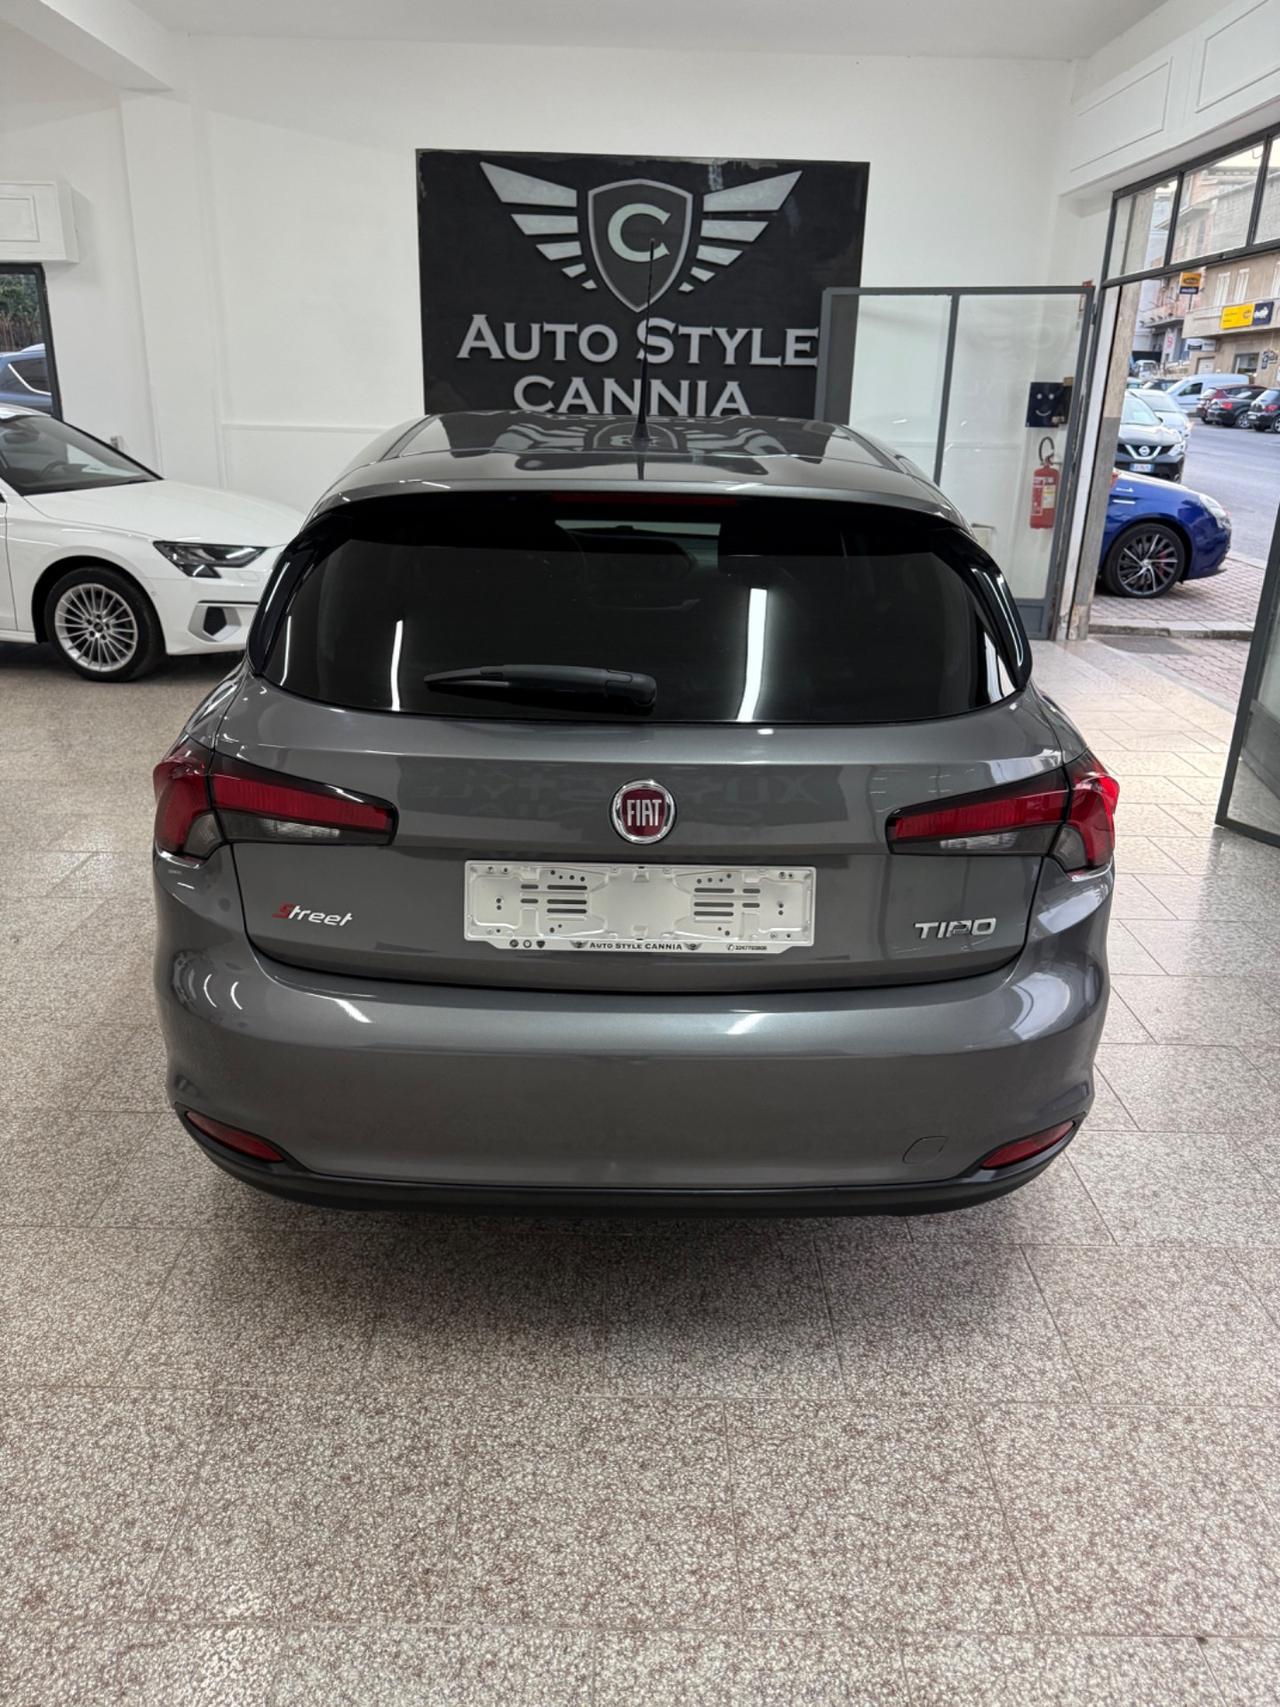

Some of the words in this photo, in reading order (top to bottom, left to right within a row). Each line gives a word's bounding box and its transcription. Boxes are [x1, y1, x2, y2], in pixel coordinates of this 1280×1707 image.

[607, 203, 671, 262] C
[457, 314, 618, 363] AUTO
[637, 318, 819, 367] STYLE
[514, 375, 752, 417] CANNIA
[627, 800, 662, 826] FIAT
[272, 902, 352, 927] Street
[915, 918, 996, 939] TIPO
